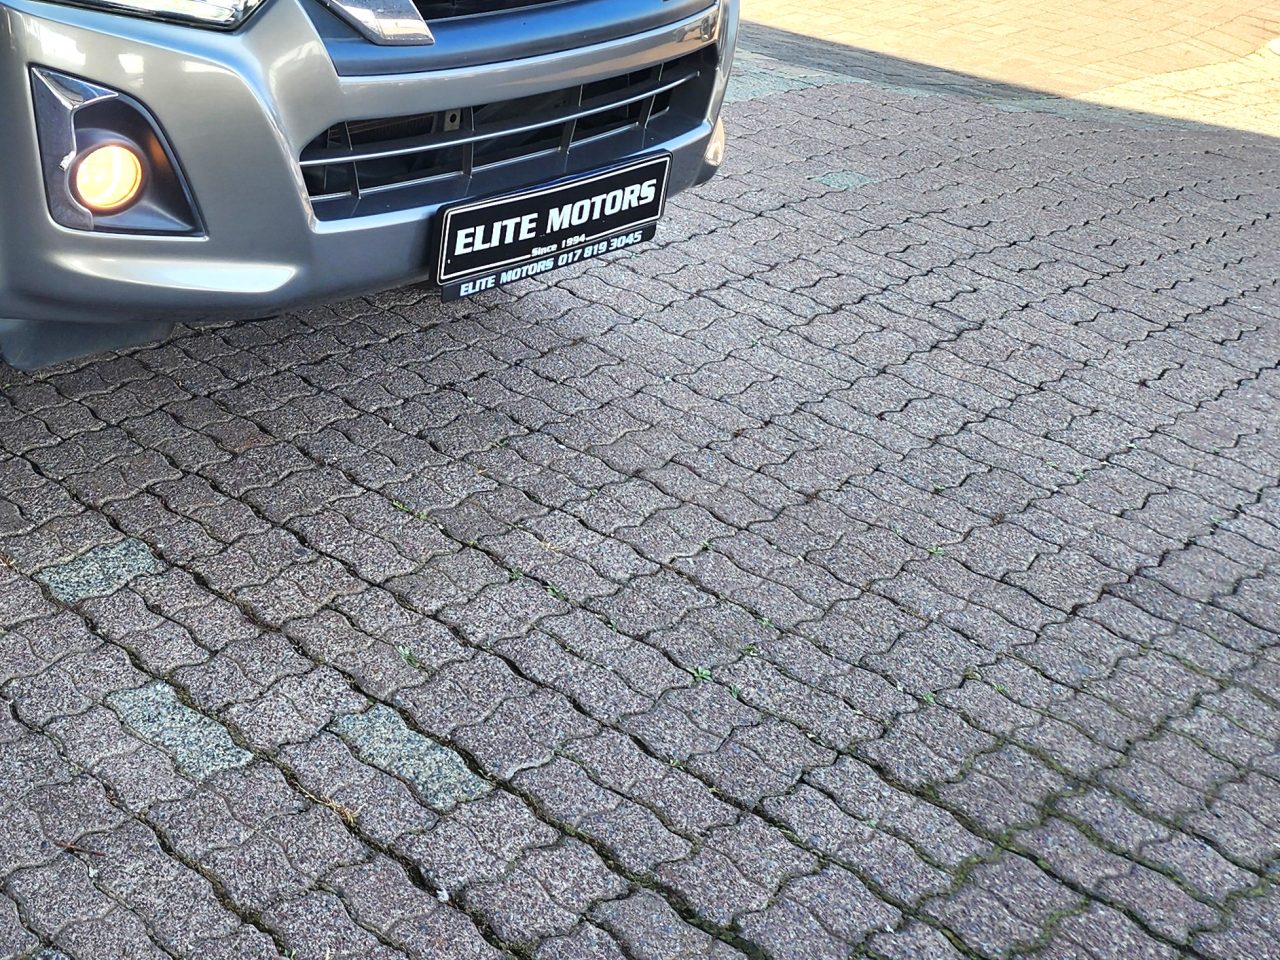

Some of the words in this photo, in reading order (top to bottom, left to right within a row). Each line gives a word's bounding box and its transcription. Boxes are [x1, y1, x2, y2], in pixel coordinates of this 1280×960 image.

[454, 213, 538, 256] ELITE
[546, 178, 657, 234] MOTORS
[531, 243, 558, 258] Since
[561, 234, 587, 249] 1994
[459, 277, 496, 298] ELITE
[499, 257, 554, 286] MOTORS
[557, 249, 582, 267] 017
[583, 240, 607, 259] 819
[608, 230, 643, 252] 3045
